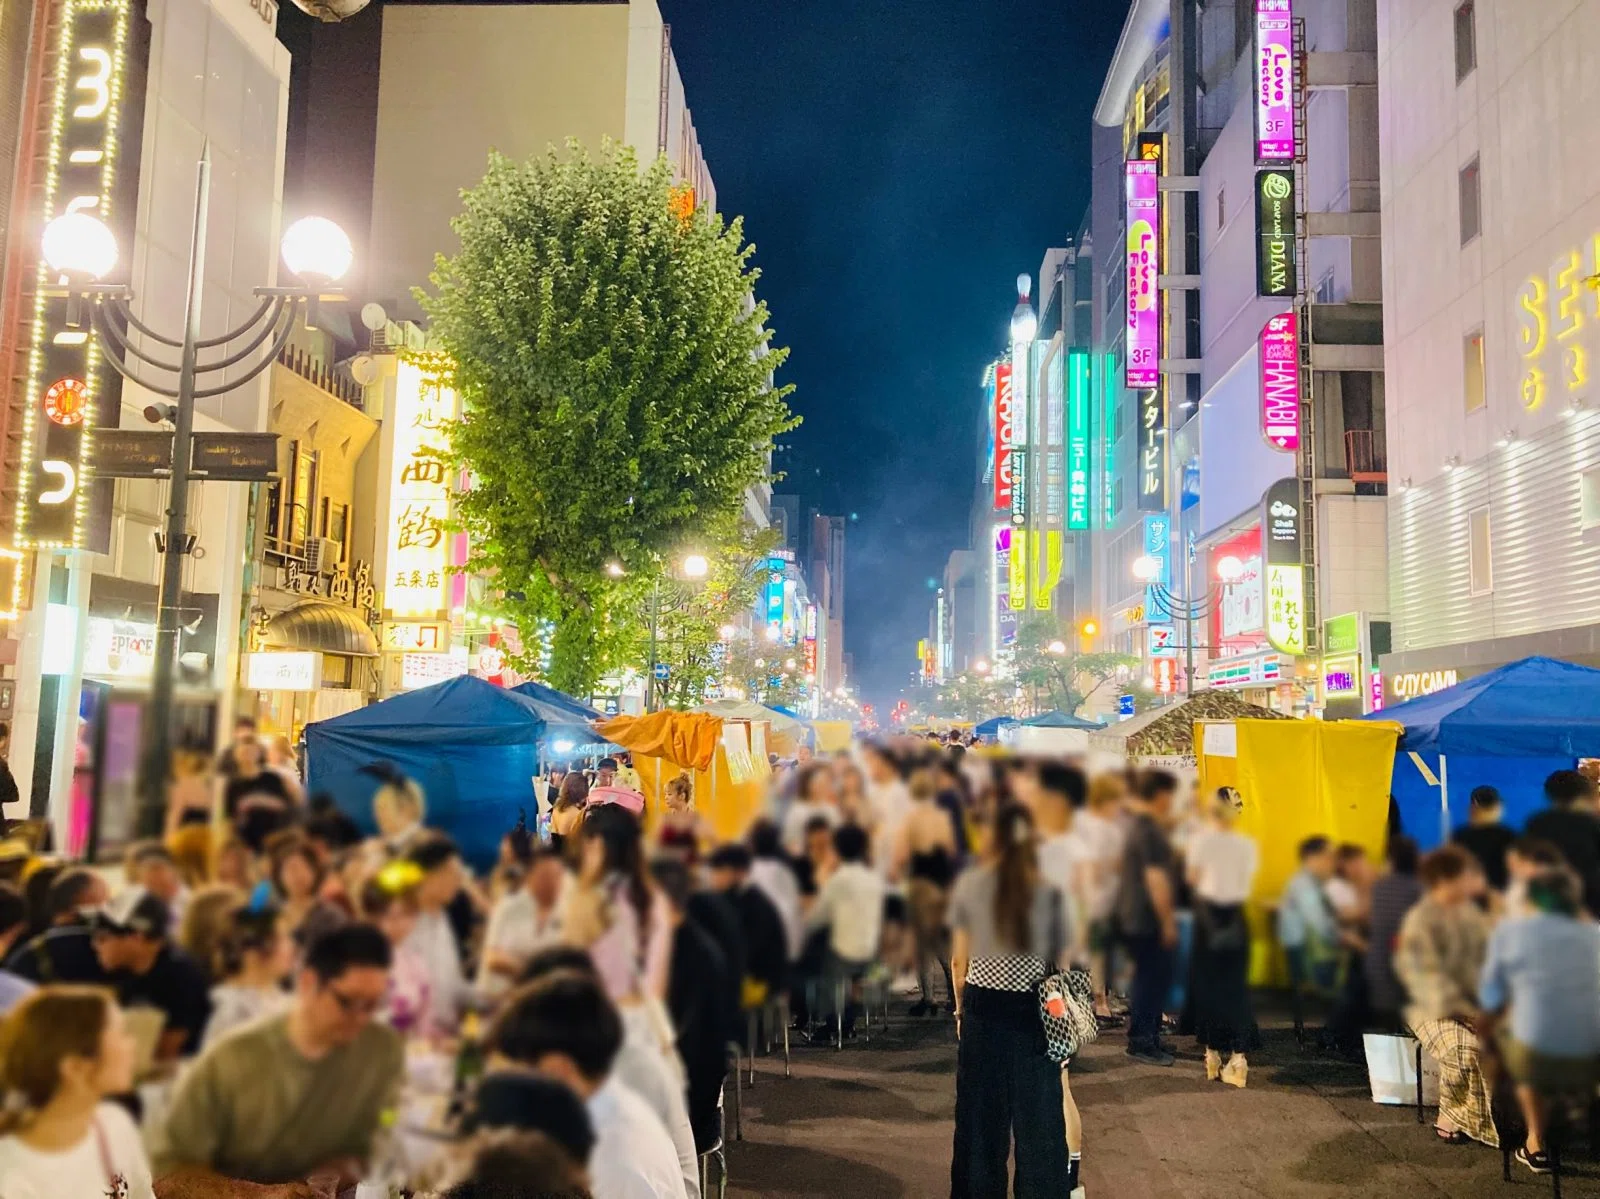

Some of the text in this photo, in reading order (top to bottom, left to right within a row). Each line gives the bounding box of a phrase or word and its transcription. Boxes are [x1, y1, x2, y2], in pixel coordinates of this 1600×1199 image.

[1261, 47, 1272, 107] Factory
[1273, 52, 1287, 102] Love
[1265, 120, 1285, 132] 3F
[1140, 233, 1152, 294] Love
[1270, 240, 1286, 293] DIANA
[1129, 252, 1139, 328] Factory
[1269, 318, 1289, 330] SF
[1132, 349, 1151, 363] 3F
[1266, 360, 1297, 422] HANABI
[1012, 483, 1021, 514] VEGAS
[394, 570, 440, 589] 五条店
[1286, 600, 1300, 645] れもん
[1394, 673, 1420, 697] CITY
